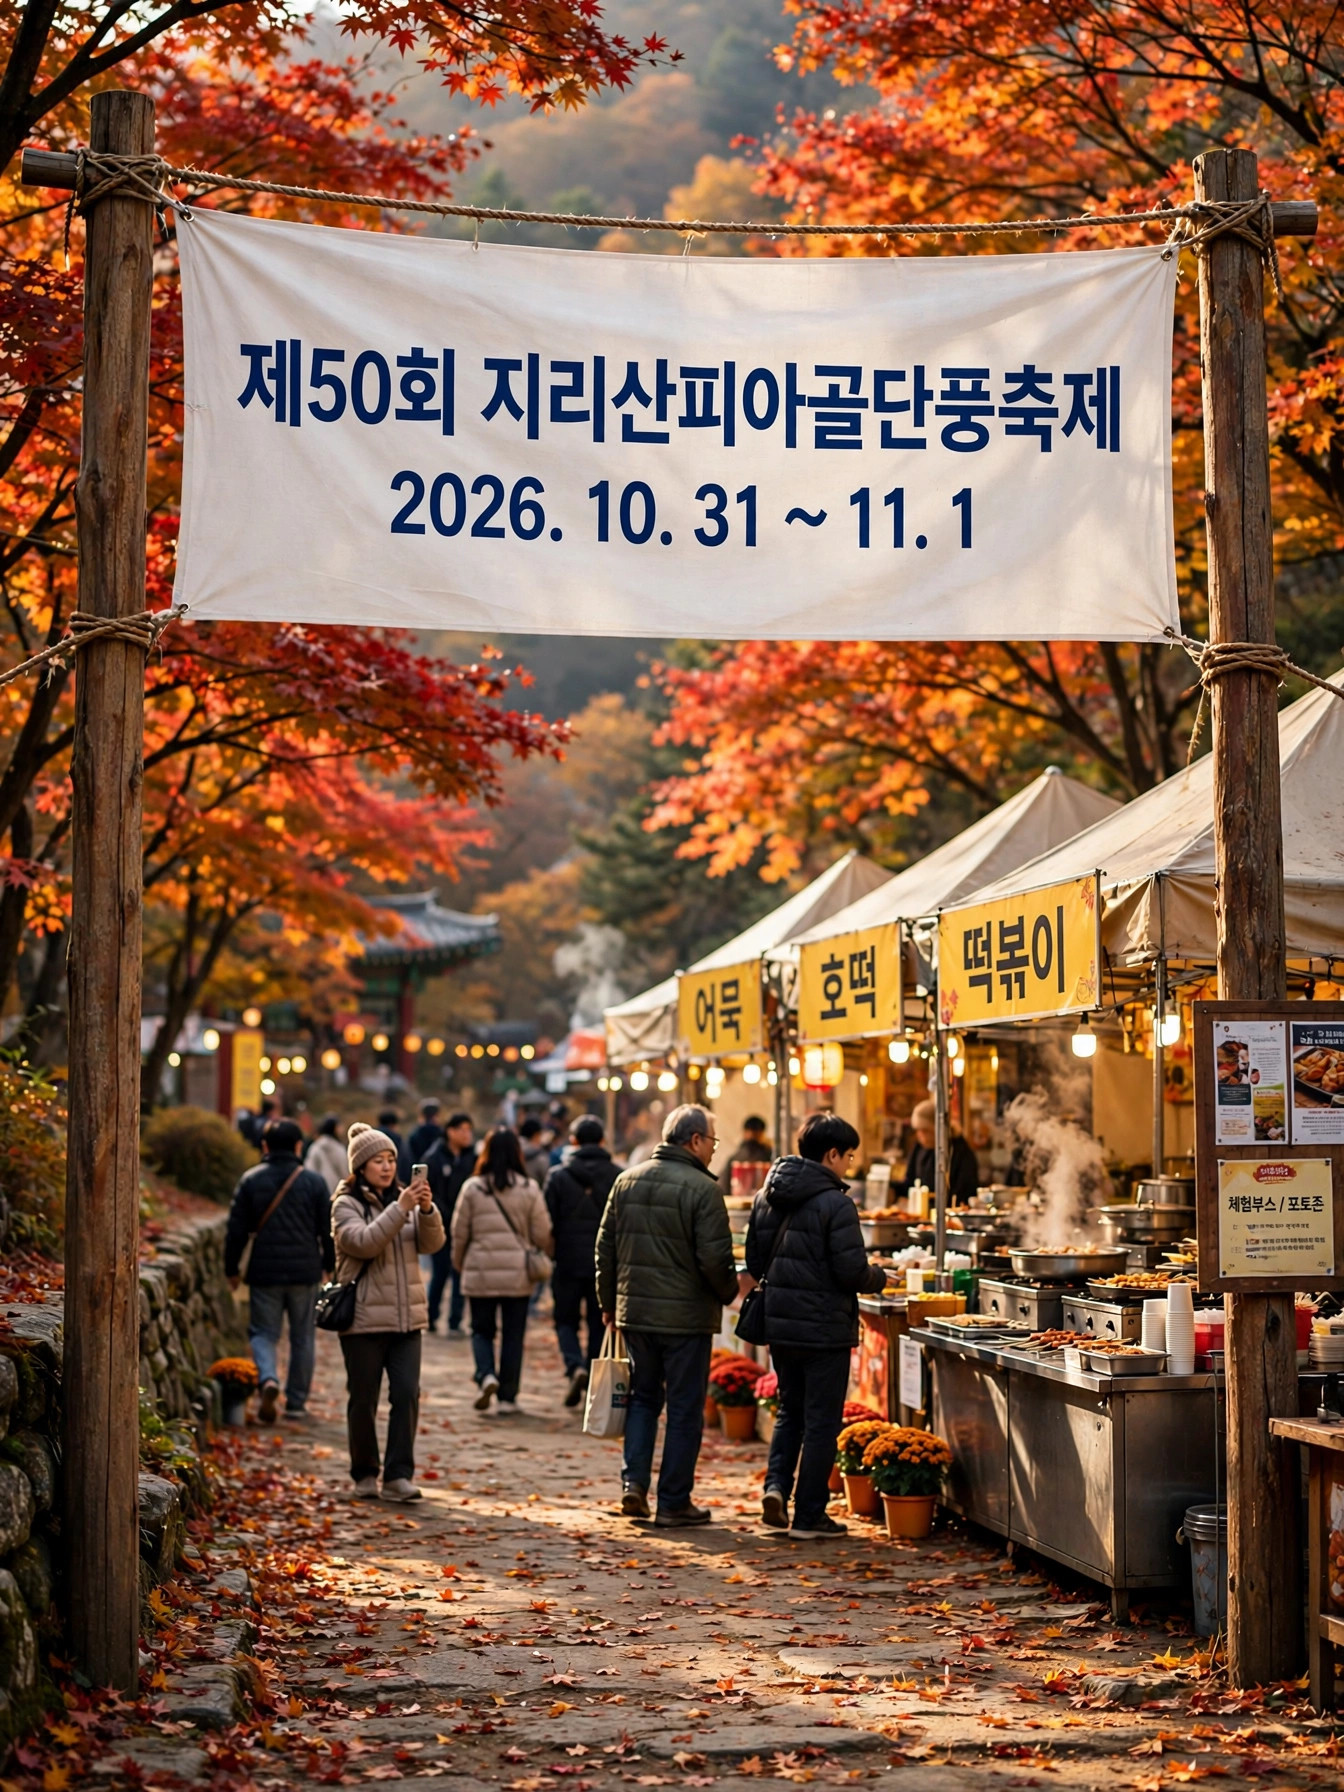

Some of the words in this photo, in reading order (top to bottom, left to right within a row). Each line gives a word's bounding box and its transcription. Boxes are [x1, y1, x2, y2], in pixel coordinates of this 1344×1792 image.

[237, 339, 455, 436] 제50회
[480, 352, 1121, 453] 지리산피아골단풍축제
[390, 470, 563, 541] 2026.
[588, 480, 673, 546] 10.
[693, 483, 757, 547] 31
[784, 507, 828, 527] ~
[849, 487, 928, 549] 11.
[952, 487, 972, 549] 1
[820, 945, 876, 1020] 호떡
[963, 905, 1065, 1004] 떡볶이
[695, 979, 742, 1043] 어묵
[1228, 1195, 1277, 1213] 체험부스
[1279, 1196, 1285, 1213] /
[1287, 1195, 1325, 1213] 포토존
